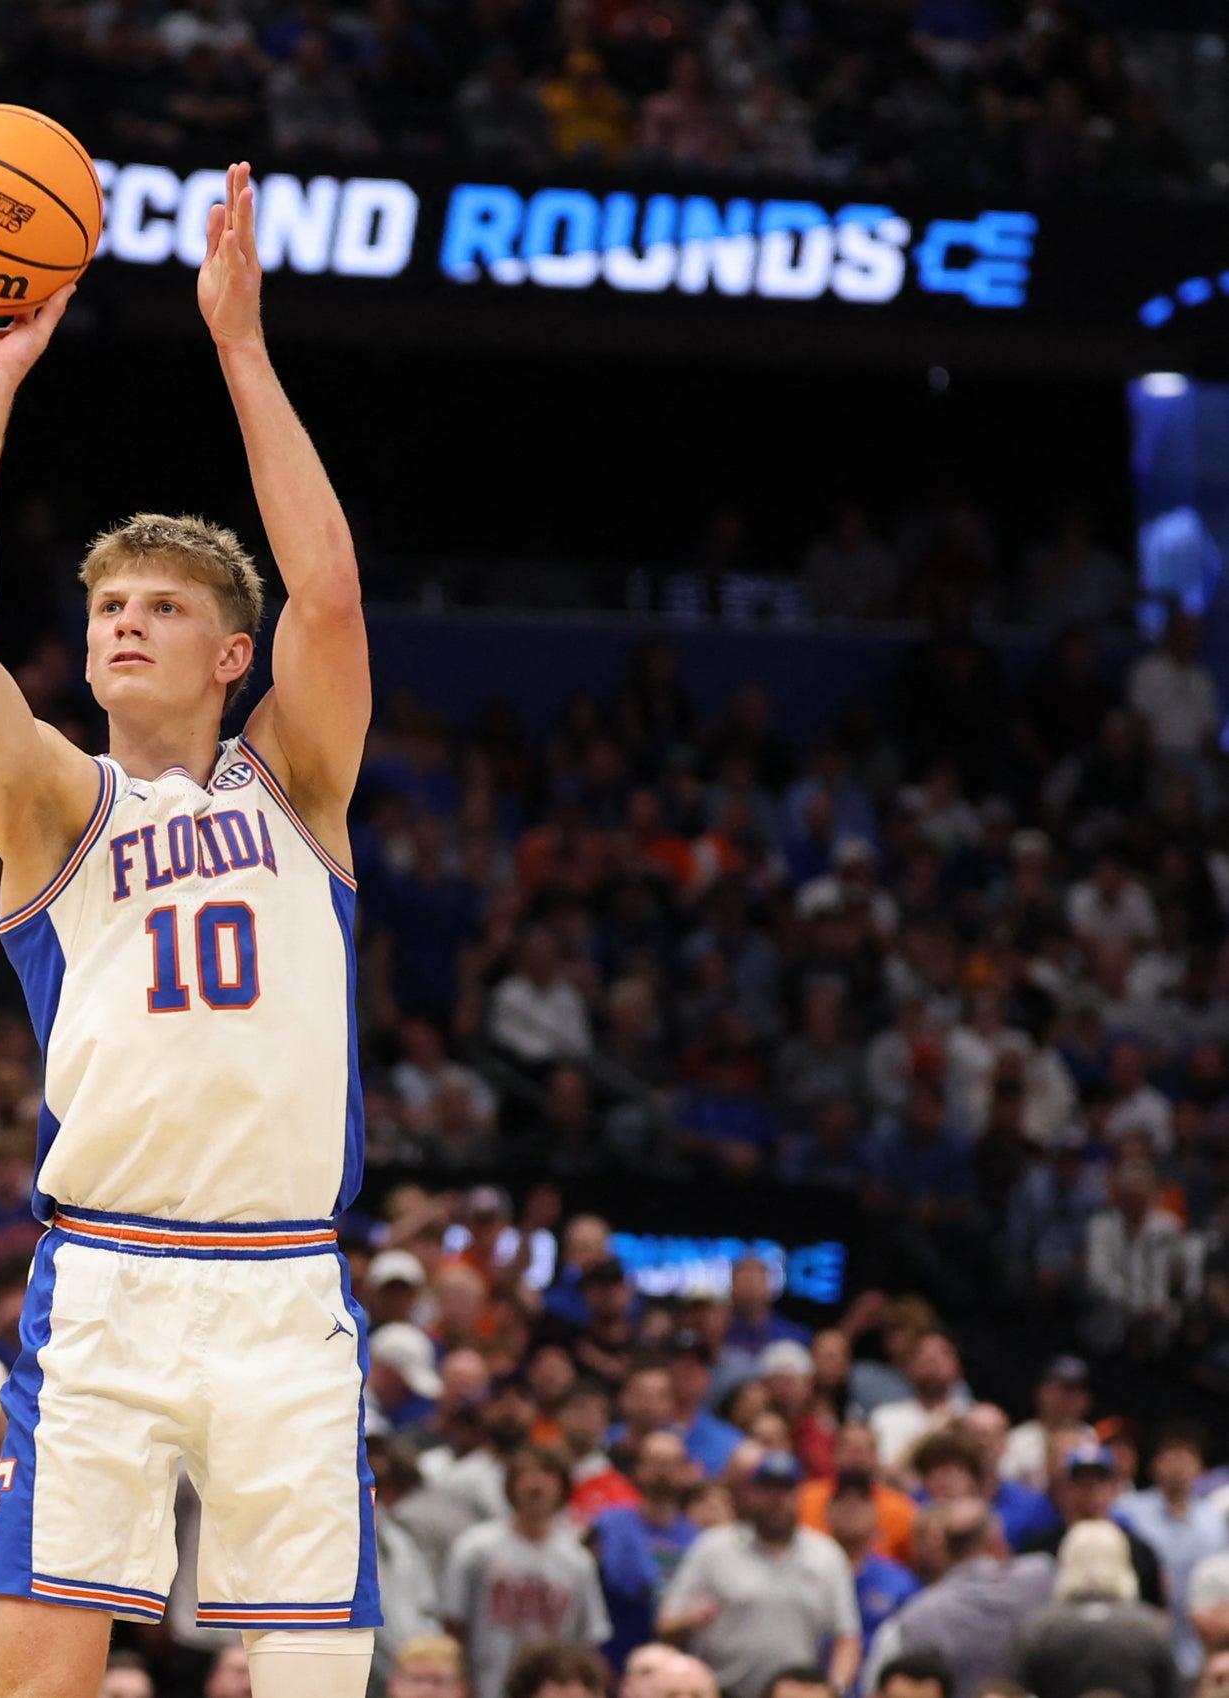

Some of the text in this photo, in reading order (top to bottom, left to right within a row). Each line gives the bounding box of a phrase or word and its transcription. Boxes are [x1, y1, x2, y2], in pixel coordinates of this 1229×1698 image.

[439, 183, 911, 303] ROUNDS
[216, 764, 252, 789] SEC
[145, 901, 260, 1013] 10
